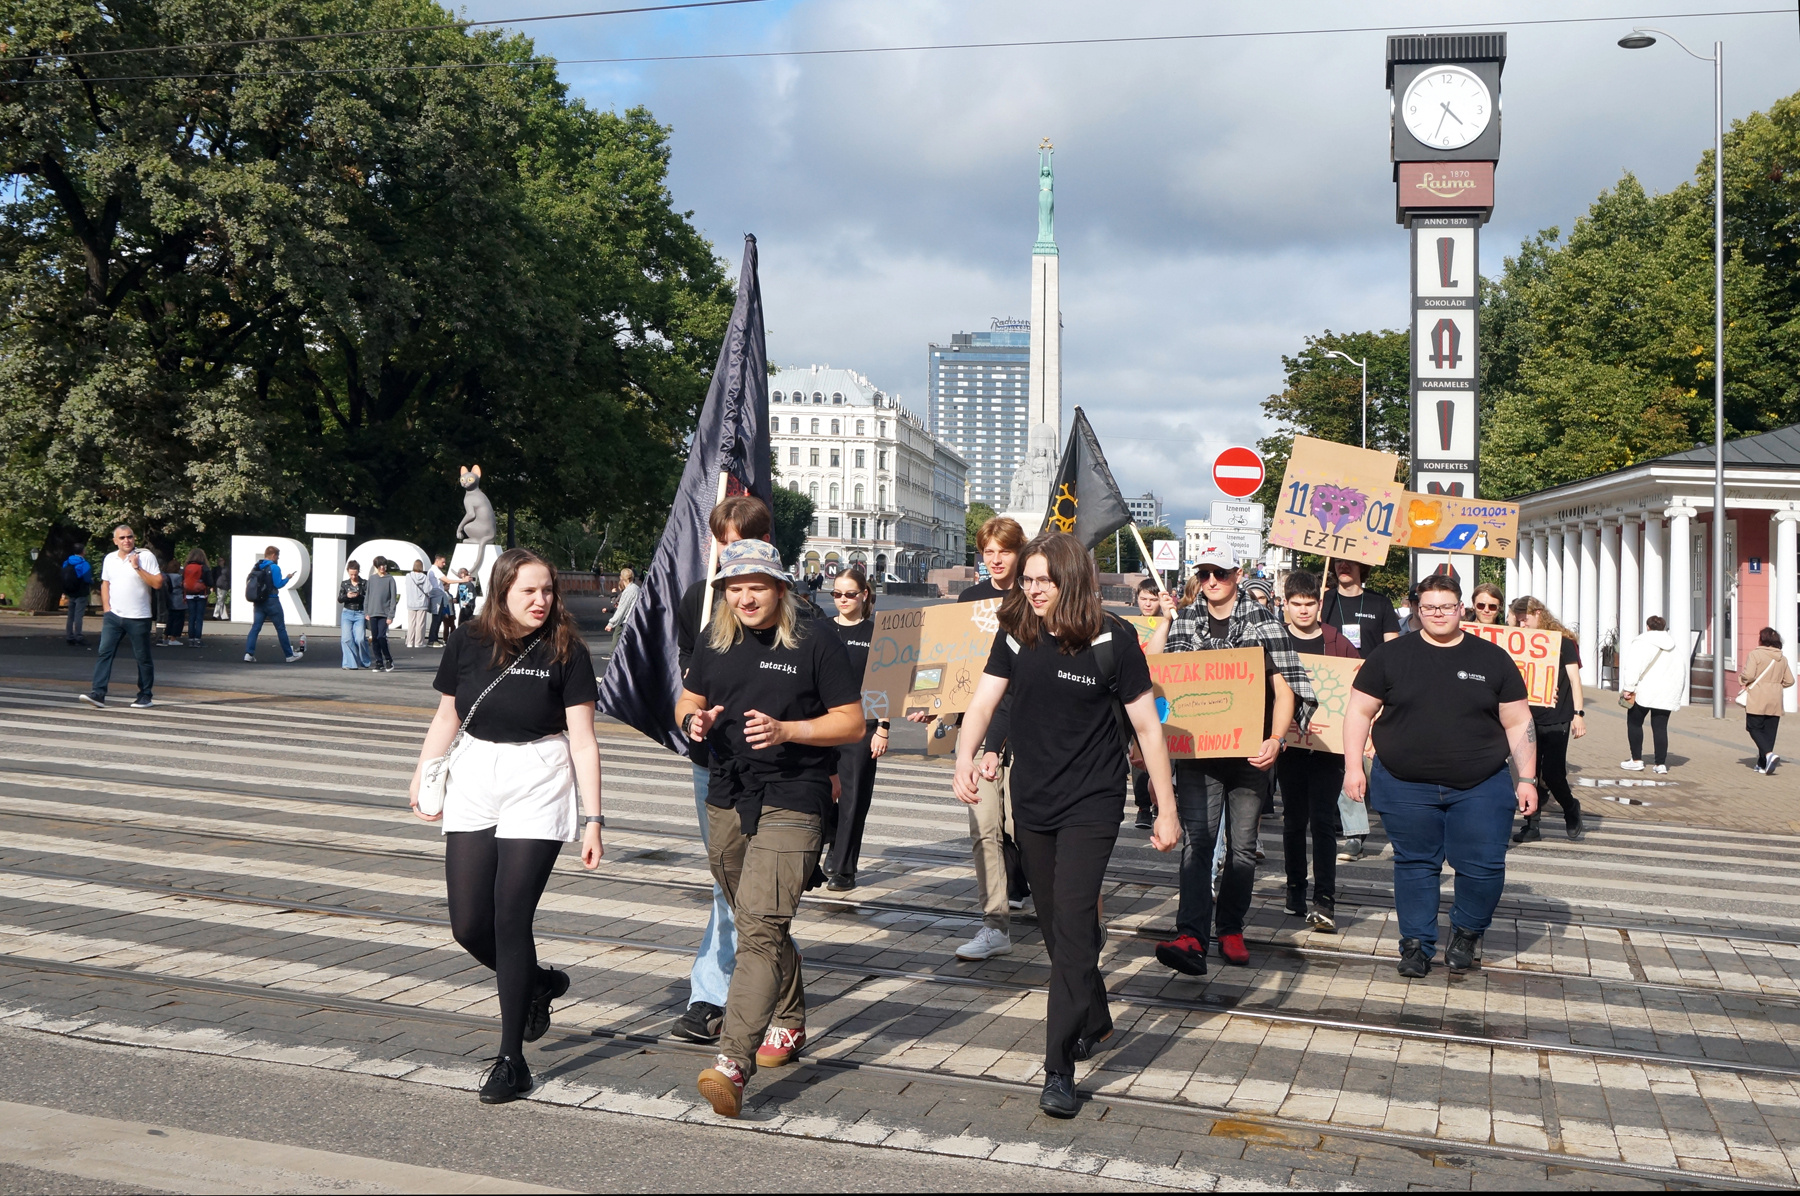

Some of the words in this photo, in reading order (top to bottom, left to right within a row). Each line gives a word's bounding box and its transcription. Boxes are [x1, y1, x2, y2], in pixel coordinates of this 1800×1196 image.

[1442, 74, 1453, 84] 12
[1410, 105, 1417, 115] 9
[1477, 105, 1484, 115] 3
[1443, 136, 1450, 146] 6
[1450, 170, 1470, 178] 1870
[1416, 172, 1477, 193] Laima
[1422, 381, 1470, 389] KARAMELES
[1423, 462, 1469, 470] KONFEKTES
[1460, 506, 1508, 517] 1101001
[1303, 529, 1358, 554] EZTF
[881, 611, 926, 631] 1101001
[760, 660, 798, 674] Datoriķi
[1057, 669, 1096, 687] Datoriķi
[1204, 661, 1255, 685] RUNU,
